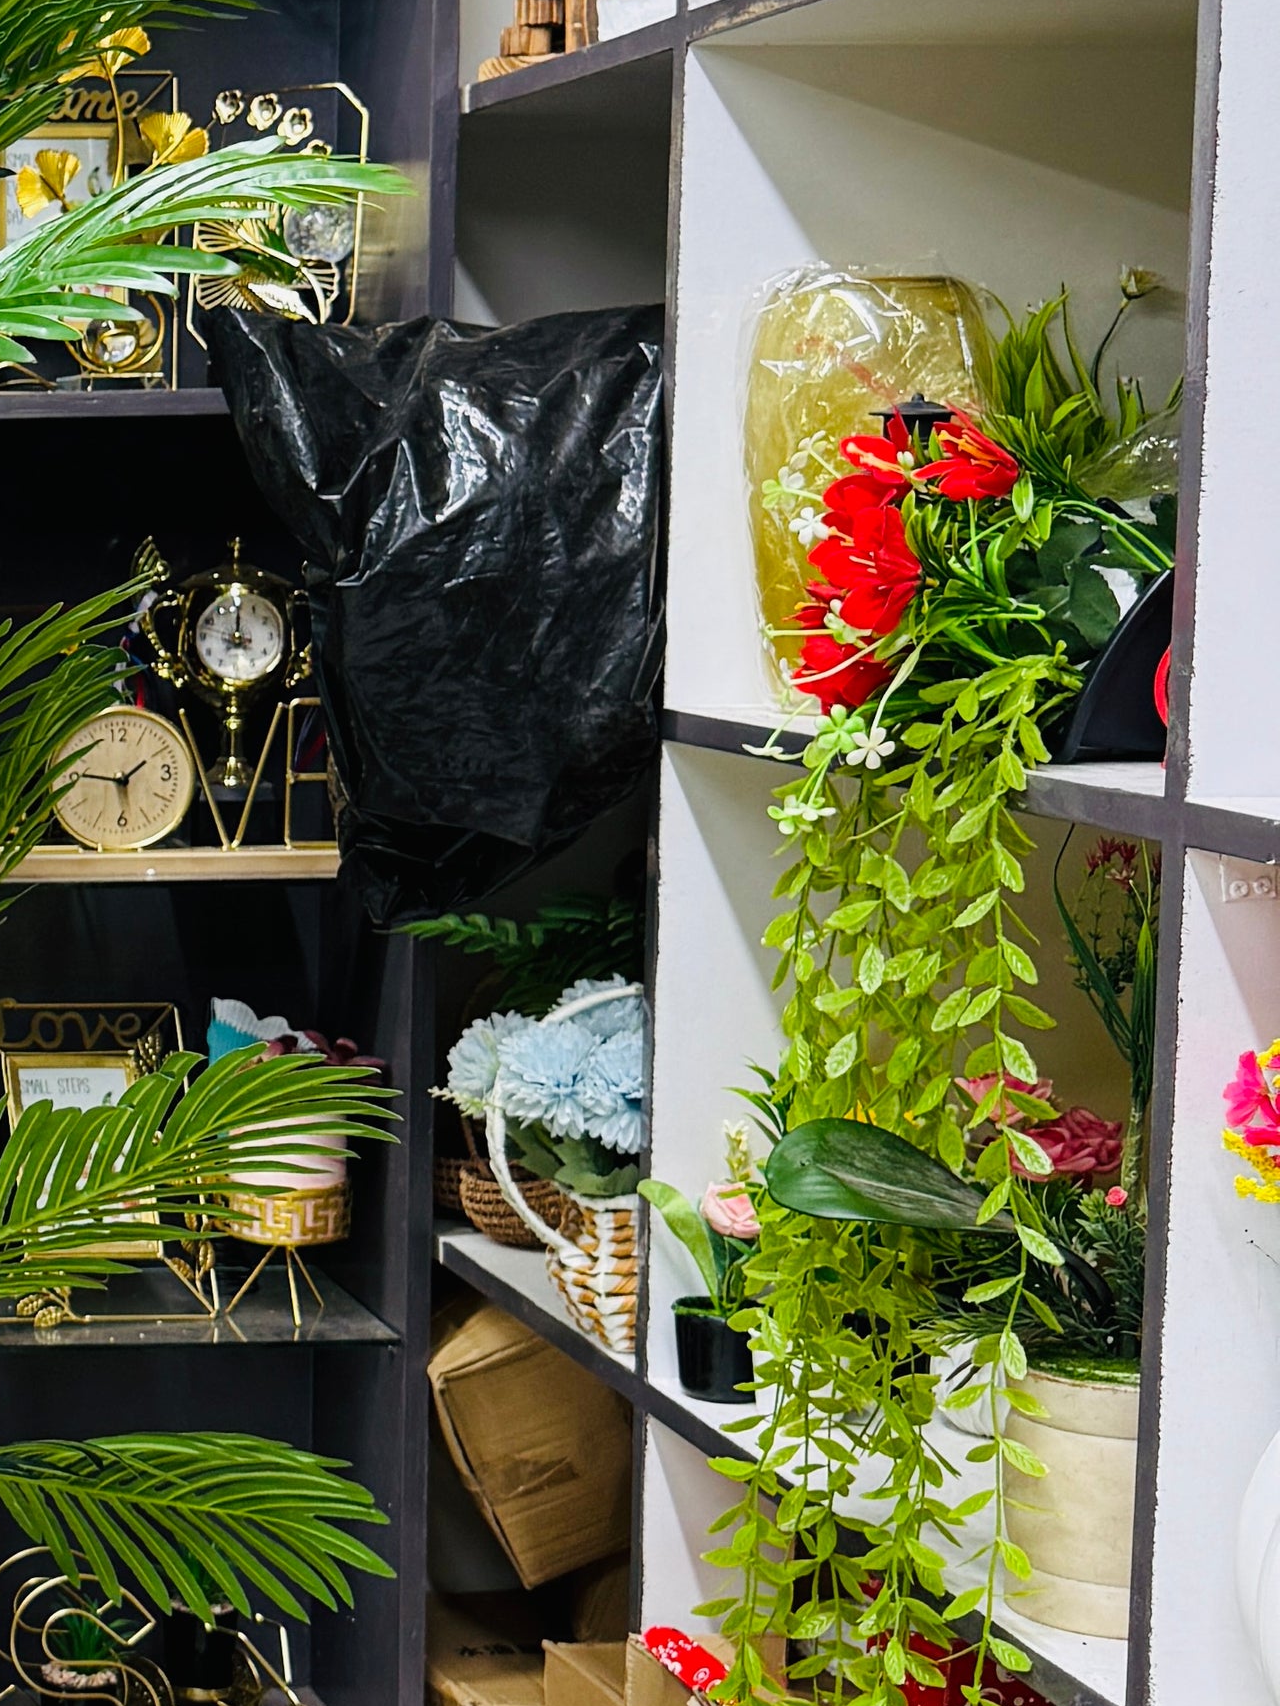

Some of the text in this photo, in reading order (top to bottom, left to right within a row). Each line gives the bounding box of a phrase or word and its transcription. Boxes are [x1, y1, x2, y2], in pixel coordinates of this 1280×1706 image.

[109, 727, 128, 744] 12
[160, 764, 173, 782] 3
[116, 809, 128, 828] 6
[57, 1076, 91, 1095] STEPS
